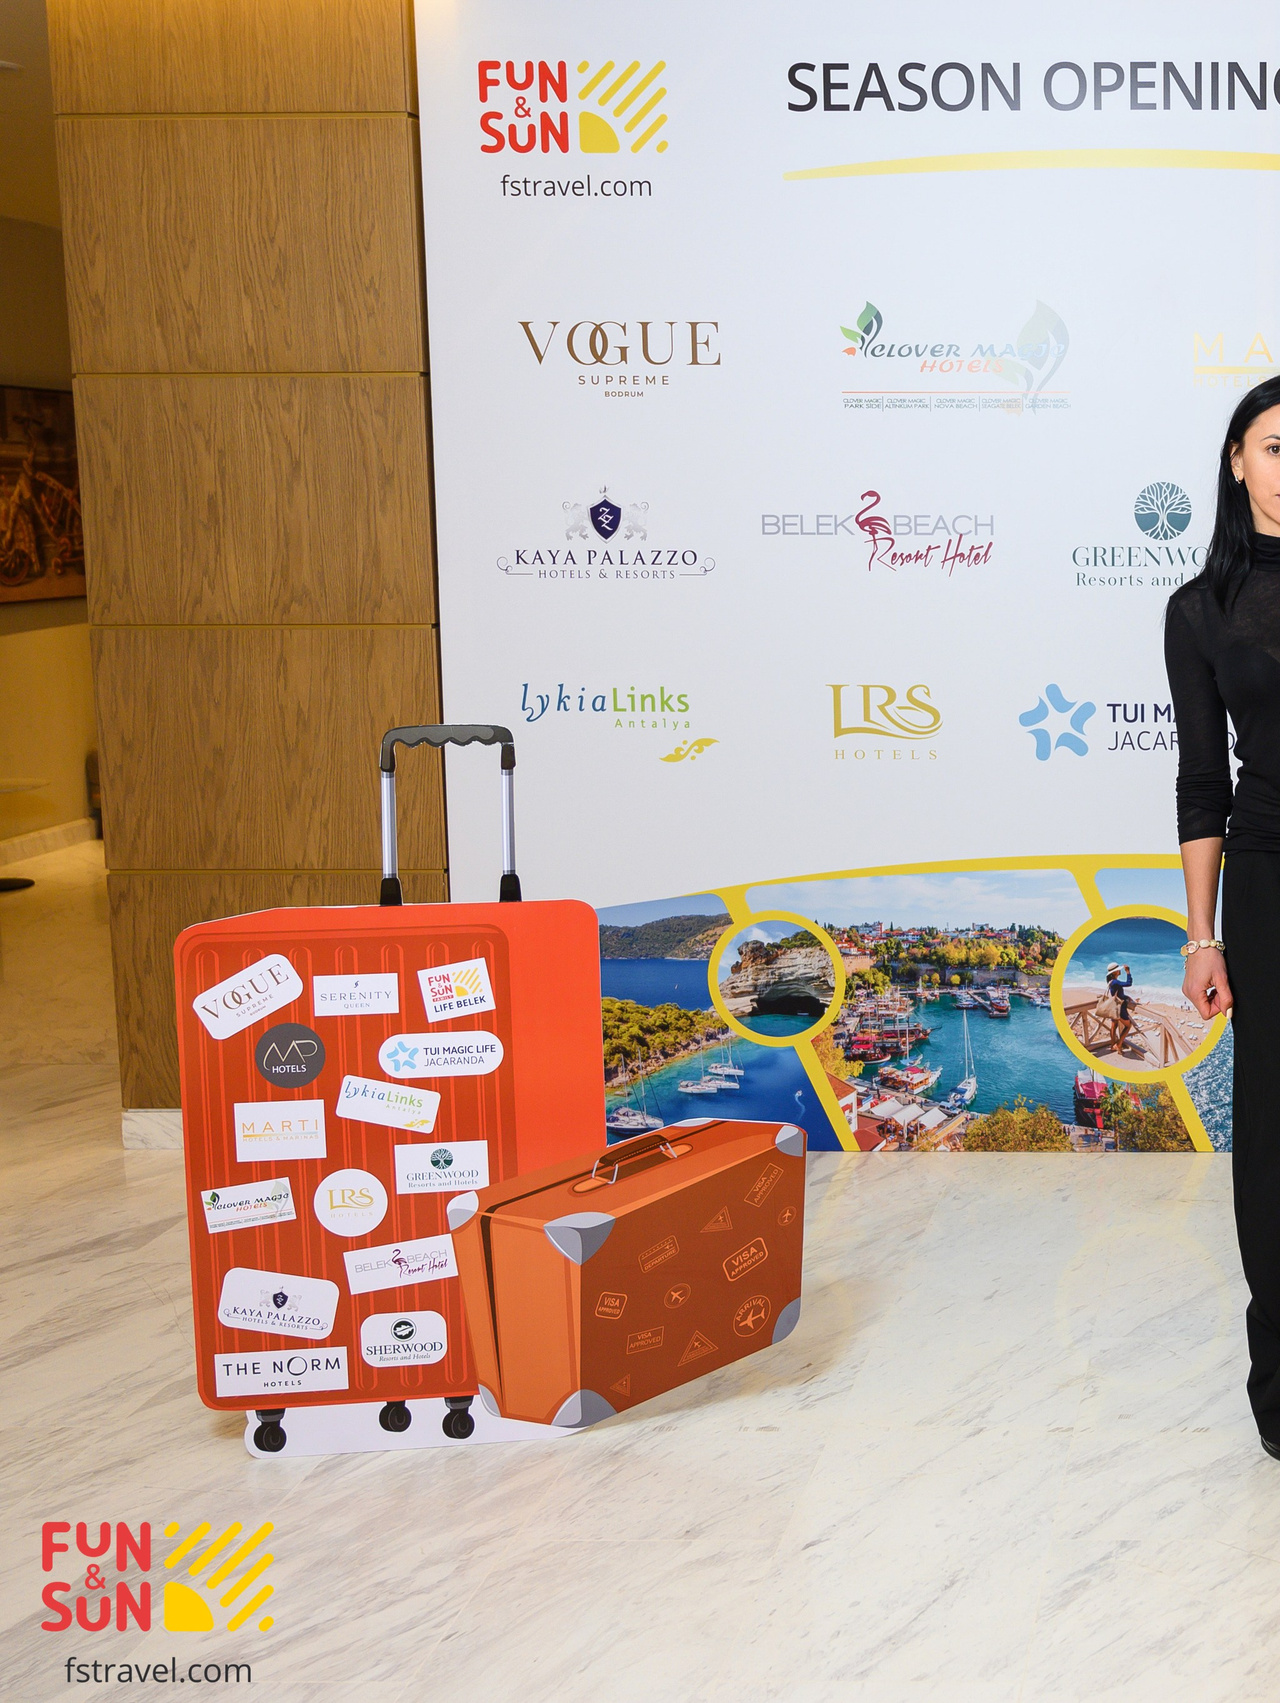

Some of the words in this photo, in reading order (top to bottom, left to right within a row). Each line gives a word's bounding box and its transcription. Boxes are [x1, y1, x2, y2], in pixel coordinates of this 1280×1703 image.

[478, 60, 567, 102] FUN
[787, 61, 1021, 112] SEASON
[514, 96, 532, 119] &
[479, 111, 569, 153] SUN
[501, 174, 653, 197] fstravel.com
[518, 320, 721, 366] VOGUE
[870, 343, 961, 358] CLOVER
[970, 343, 1066, 361] MAGIC
[920, 358, 1005, 373] HOTELS
[578, 375, 670, 385] SUPREME
[604, 390, 645, 398] BODRUM
[761, 514, 855, 536] BELEK
[893, 514, 994, 536] BEACH
[515, 549, 578, 565] KAYA
[587, 549, 698, 565] PALAZZO
[865, 537, 941, 571] Resort
[941, 534, 993, 577] Hotel
[1072, 546, 1209, 567] GREENWO
[538, 569, 591, 579] HOTELS
[598, 569, 608, 579] &
[615, 569, 675, 580] RESORTS
[1076, 572, 1143, 586] Resorts
[1151, 572, 1184, 586] and
[825, 684, 943, 740] LRS
[1106, 703, 1145, 723] TUI
[614, 718, 691, 731] Antalya
[835, 749, 938, 760] HOTELS
[427, 973, 451, 987] FUN
[201, 963, 289, 1019] VOGUE
[320, 991, 392, 1001] SERENITY
[430, 984, 453, 998] SUN
[236, 994, 274, 1018] SUPREME
[434, 1002, 454, 1013] LIFE
[456, 995, 487, 1009] BELEK
[423, 1047, 440, 1056] TUI
[442, 1045, 474, 1055] MAGIC
[476, 1044, 496, 1053] LIFE
[272, 1064, 307, 1073] HOTELS
[424, 1056, 485, 1067] JACARANDA
[242, 1119, 318, 1134] MARTI
[406, 1170, 479, 1181] GREENWOOD
[216, 1200, 250, 1210] CLOVER
[254, 1192, 289, 1203] MAGIC
[327, 1188, 374, 1210] LRS
[354, 1259, 392, 1273] BELEK
[406, 1249, 447, 1263] BEACH
[731, 1251, 764, 1277] APPROVED
[732, 1246, 758, 1266] VISA
[604, 1297, 620, 1307] VISA
[736, 1298, 765, 1322] ARRIVAL
[233, 1306, 263, 1318] KAYA
[267, 1312, 321, 1326] PALAZZO
[629, 1336, 661, 1348] APPROVED
[637, 1332, 652, 1340] VISA
[366, 1342, 443, 1356] SHERWOOD
[223, 1362, 262, 1376] THE
[273, 1356, 341, 1376] NORM
[263, 1380, 302, 1388] HOTELS
